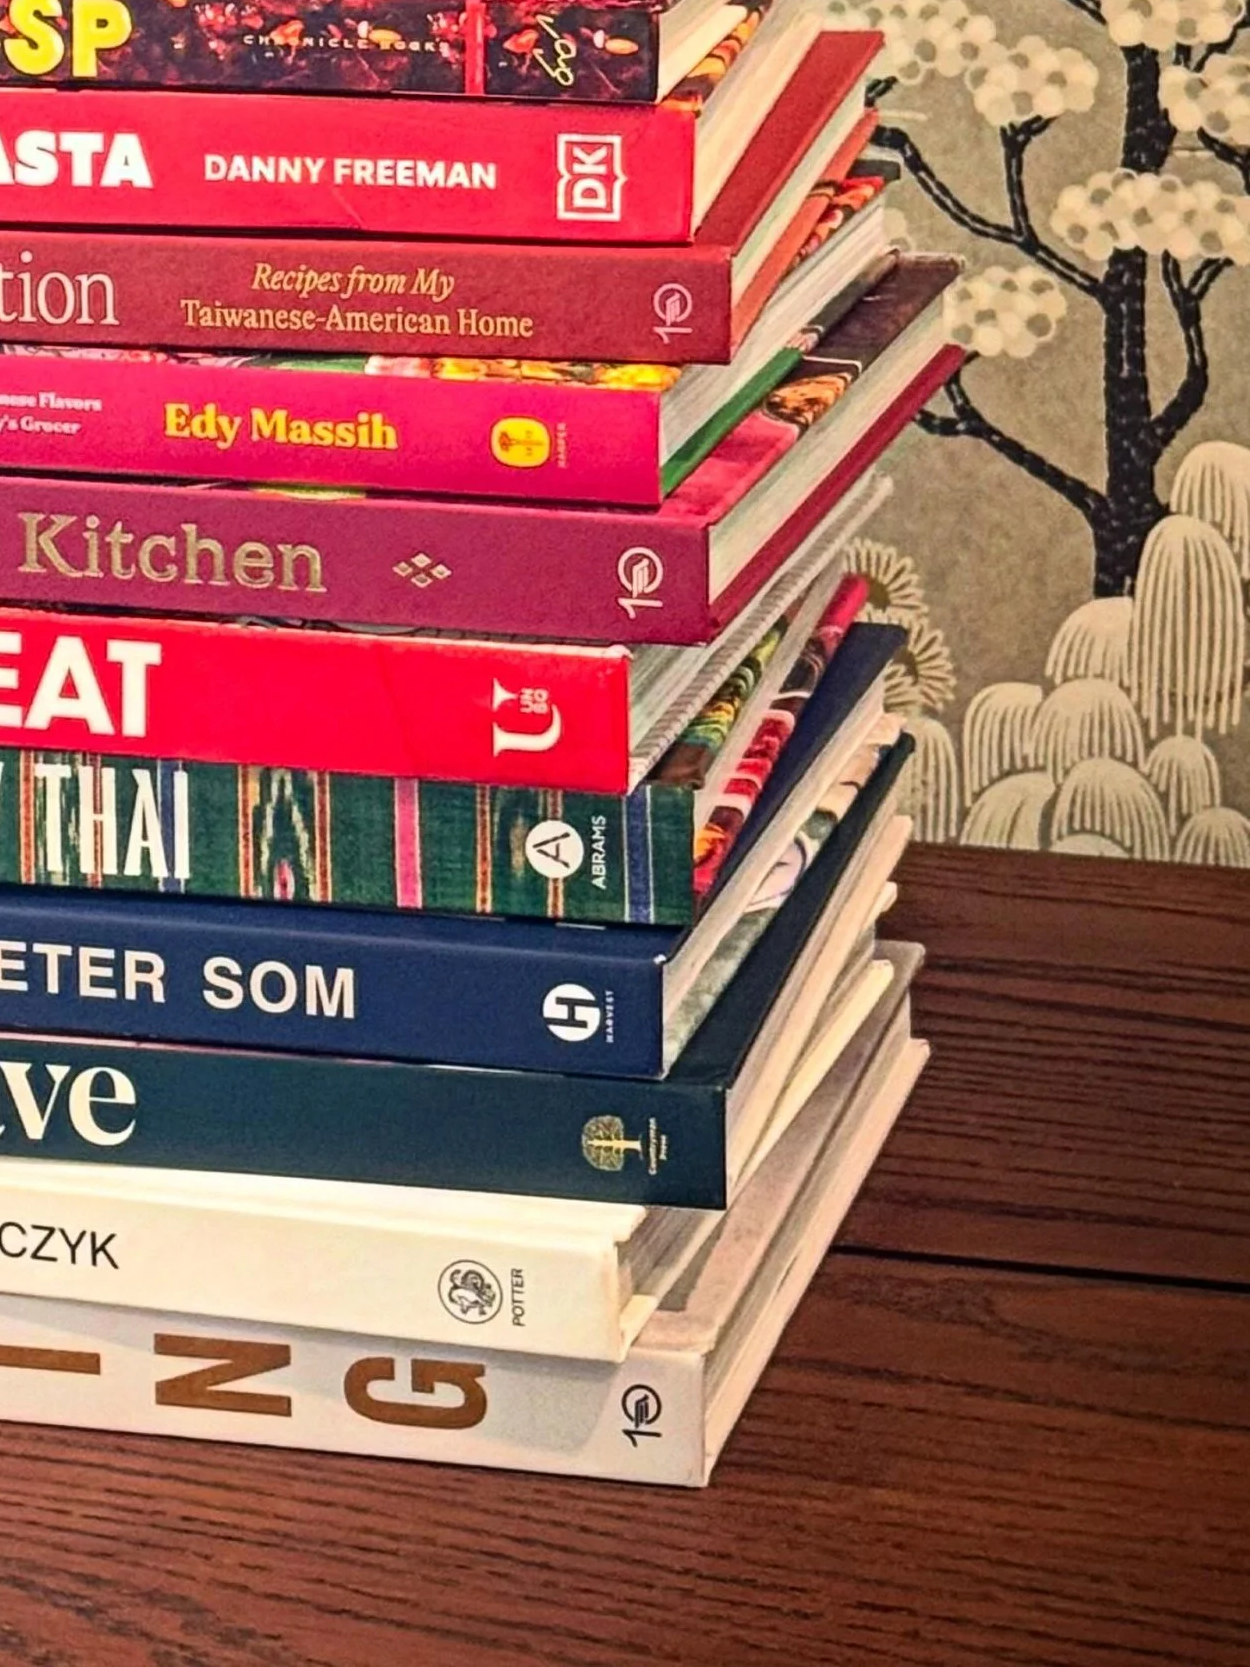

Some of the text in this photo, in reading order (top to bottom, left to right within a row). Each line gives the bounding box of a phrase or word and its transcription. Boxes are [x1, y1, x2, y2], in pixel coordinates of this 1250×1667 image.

[204, 154, 496, 189] DANNY FREEMAN
[570, 139, 609, 213] DK
[251, 263, 455, 302] Recipes from My
[180, 298, 535, 339] Taiwanese-American Home
[20, 416, 81, 435] Grocer
[38, 393, 102, 412] Flavors
[164, 404, 398, 451] Edy Massih
[18, 509, 329, 594] Kitchen
[34, 759, 191, 880] THAI
[591, 815, 607, 890] ABRAMS
[203, 956, 356, 1019] SOM
[605, 990, 614, 1043] HARVEST
[511, 1268, 525, 1327] POTTER
